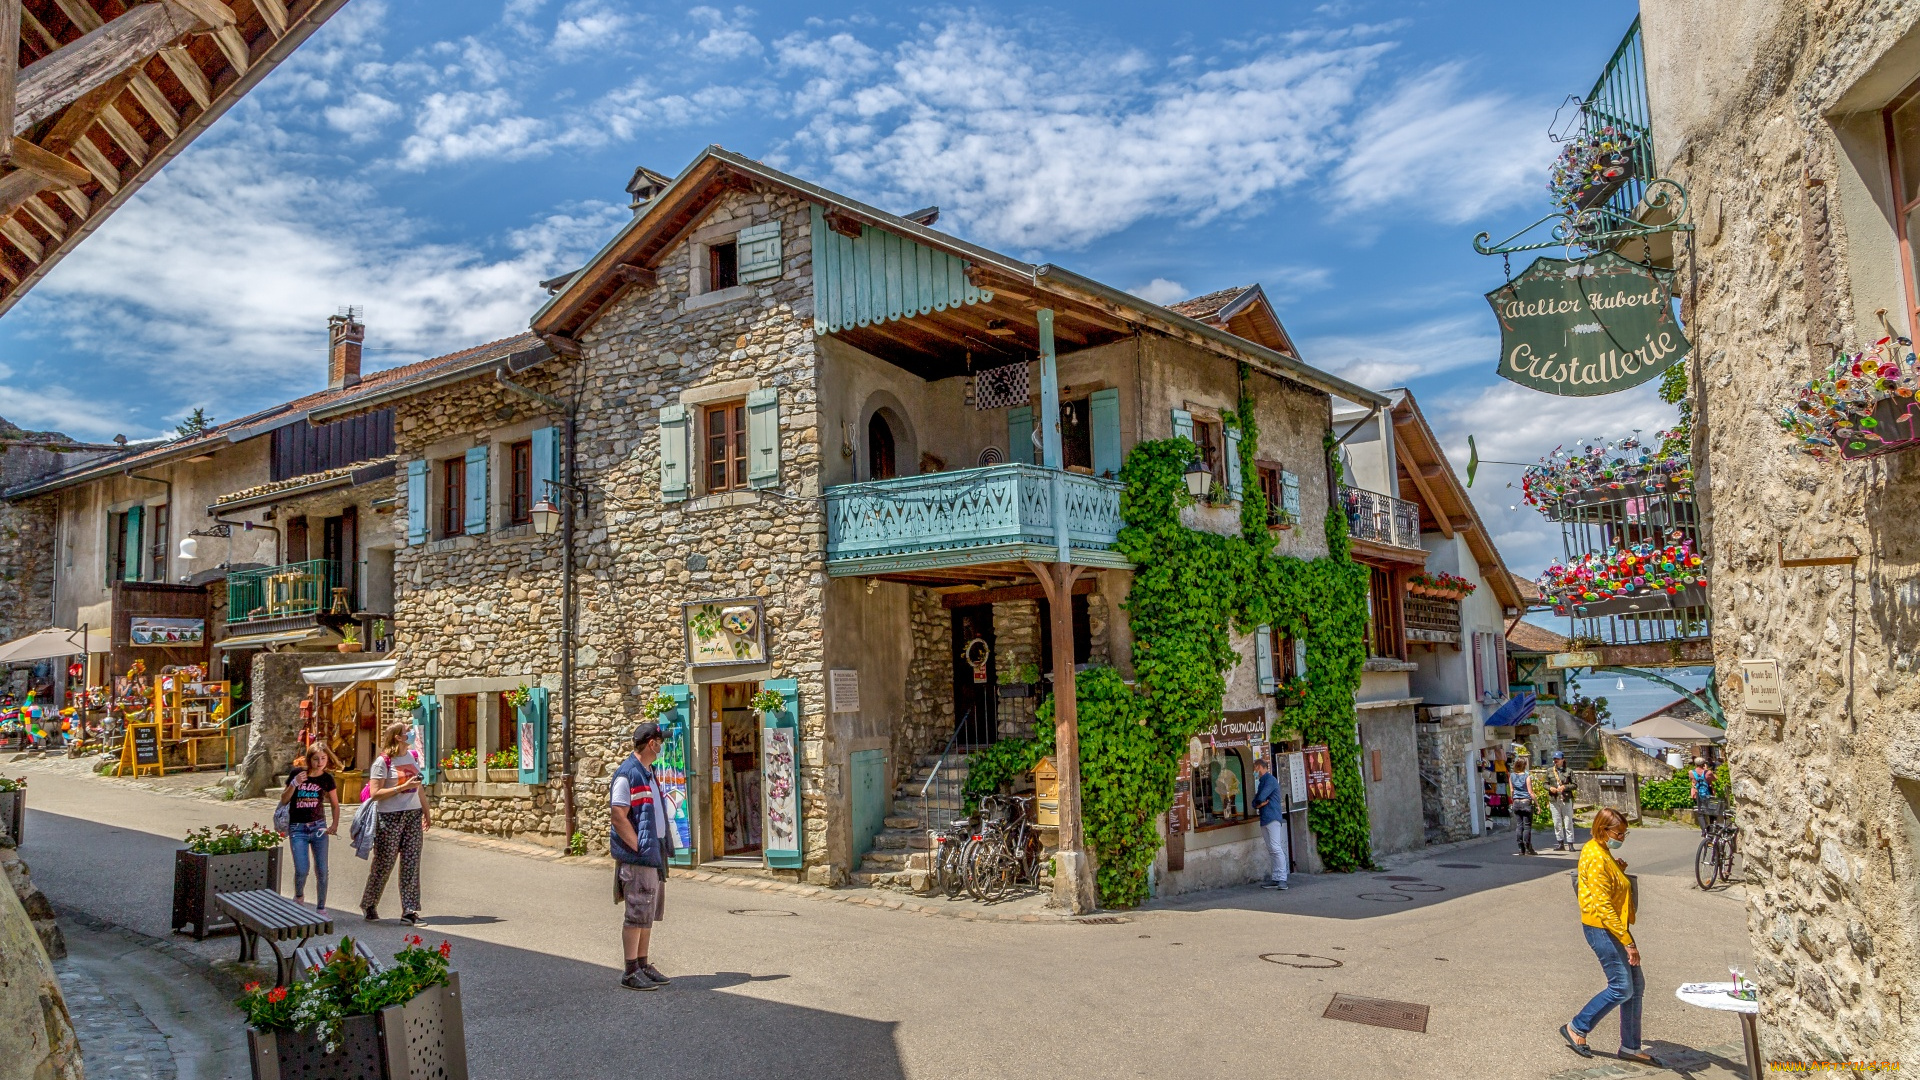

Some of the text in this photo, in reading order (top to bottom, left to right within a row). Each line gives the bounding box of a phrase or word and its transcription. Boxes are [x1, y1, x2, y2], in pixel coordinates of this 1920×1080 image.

[1505, 288, 1661, 319] Atelier Hubert
[1510, 332, 1677, 385] Cristallerie
[1765, 670, 1773, 681] Rue
[1751, 685, 1760, 695] Paul
[1221, 716, 1265, 736] Gourmande
